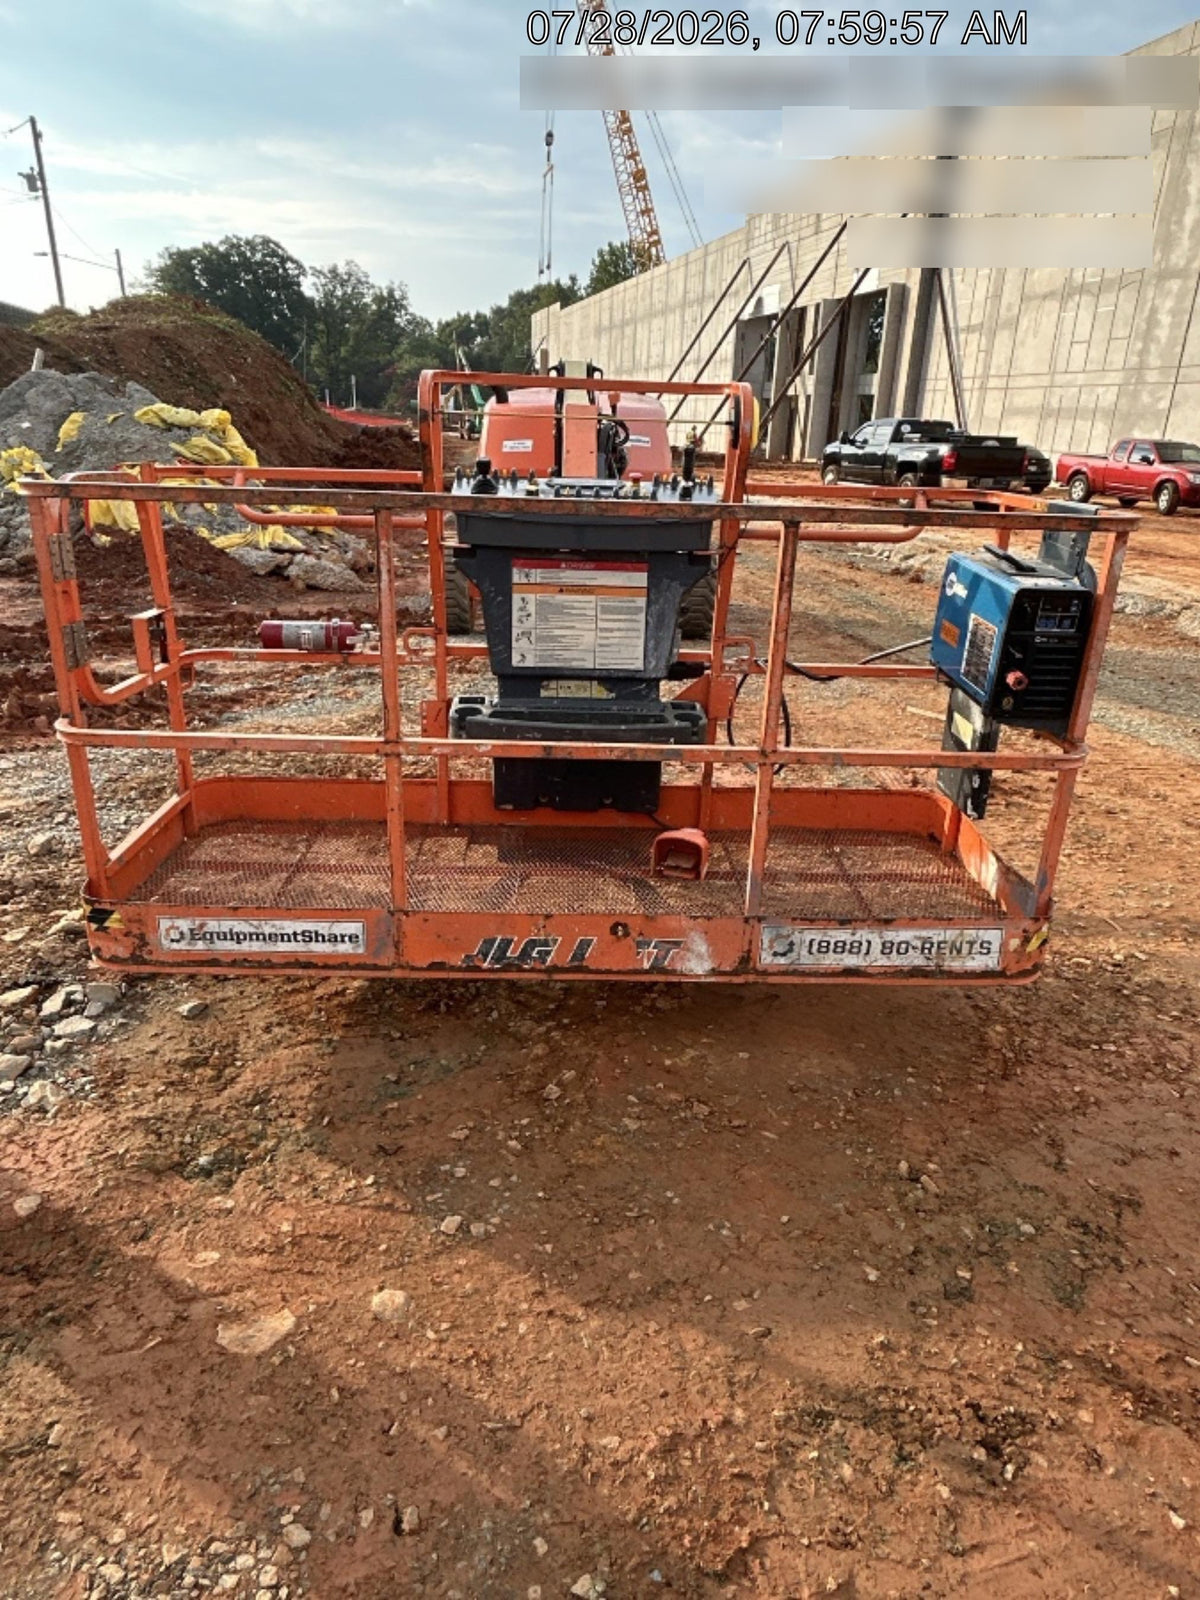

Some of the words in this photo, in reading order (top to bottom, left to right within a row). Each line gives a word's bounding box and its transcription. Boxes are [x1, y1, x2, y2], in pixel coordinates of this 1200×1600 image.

[188, 927, 361, 945] EquipmentShare
[807, 938, 873, 956] (888)
[879, 939, 994, 957] 80-RENTS
